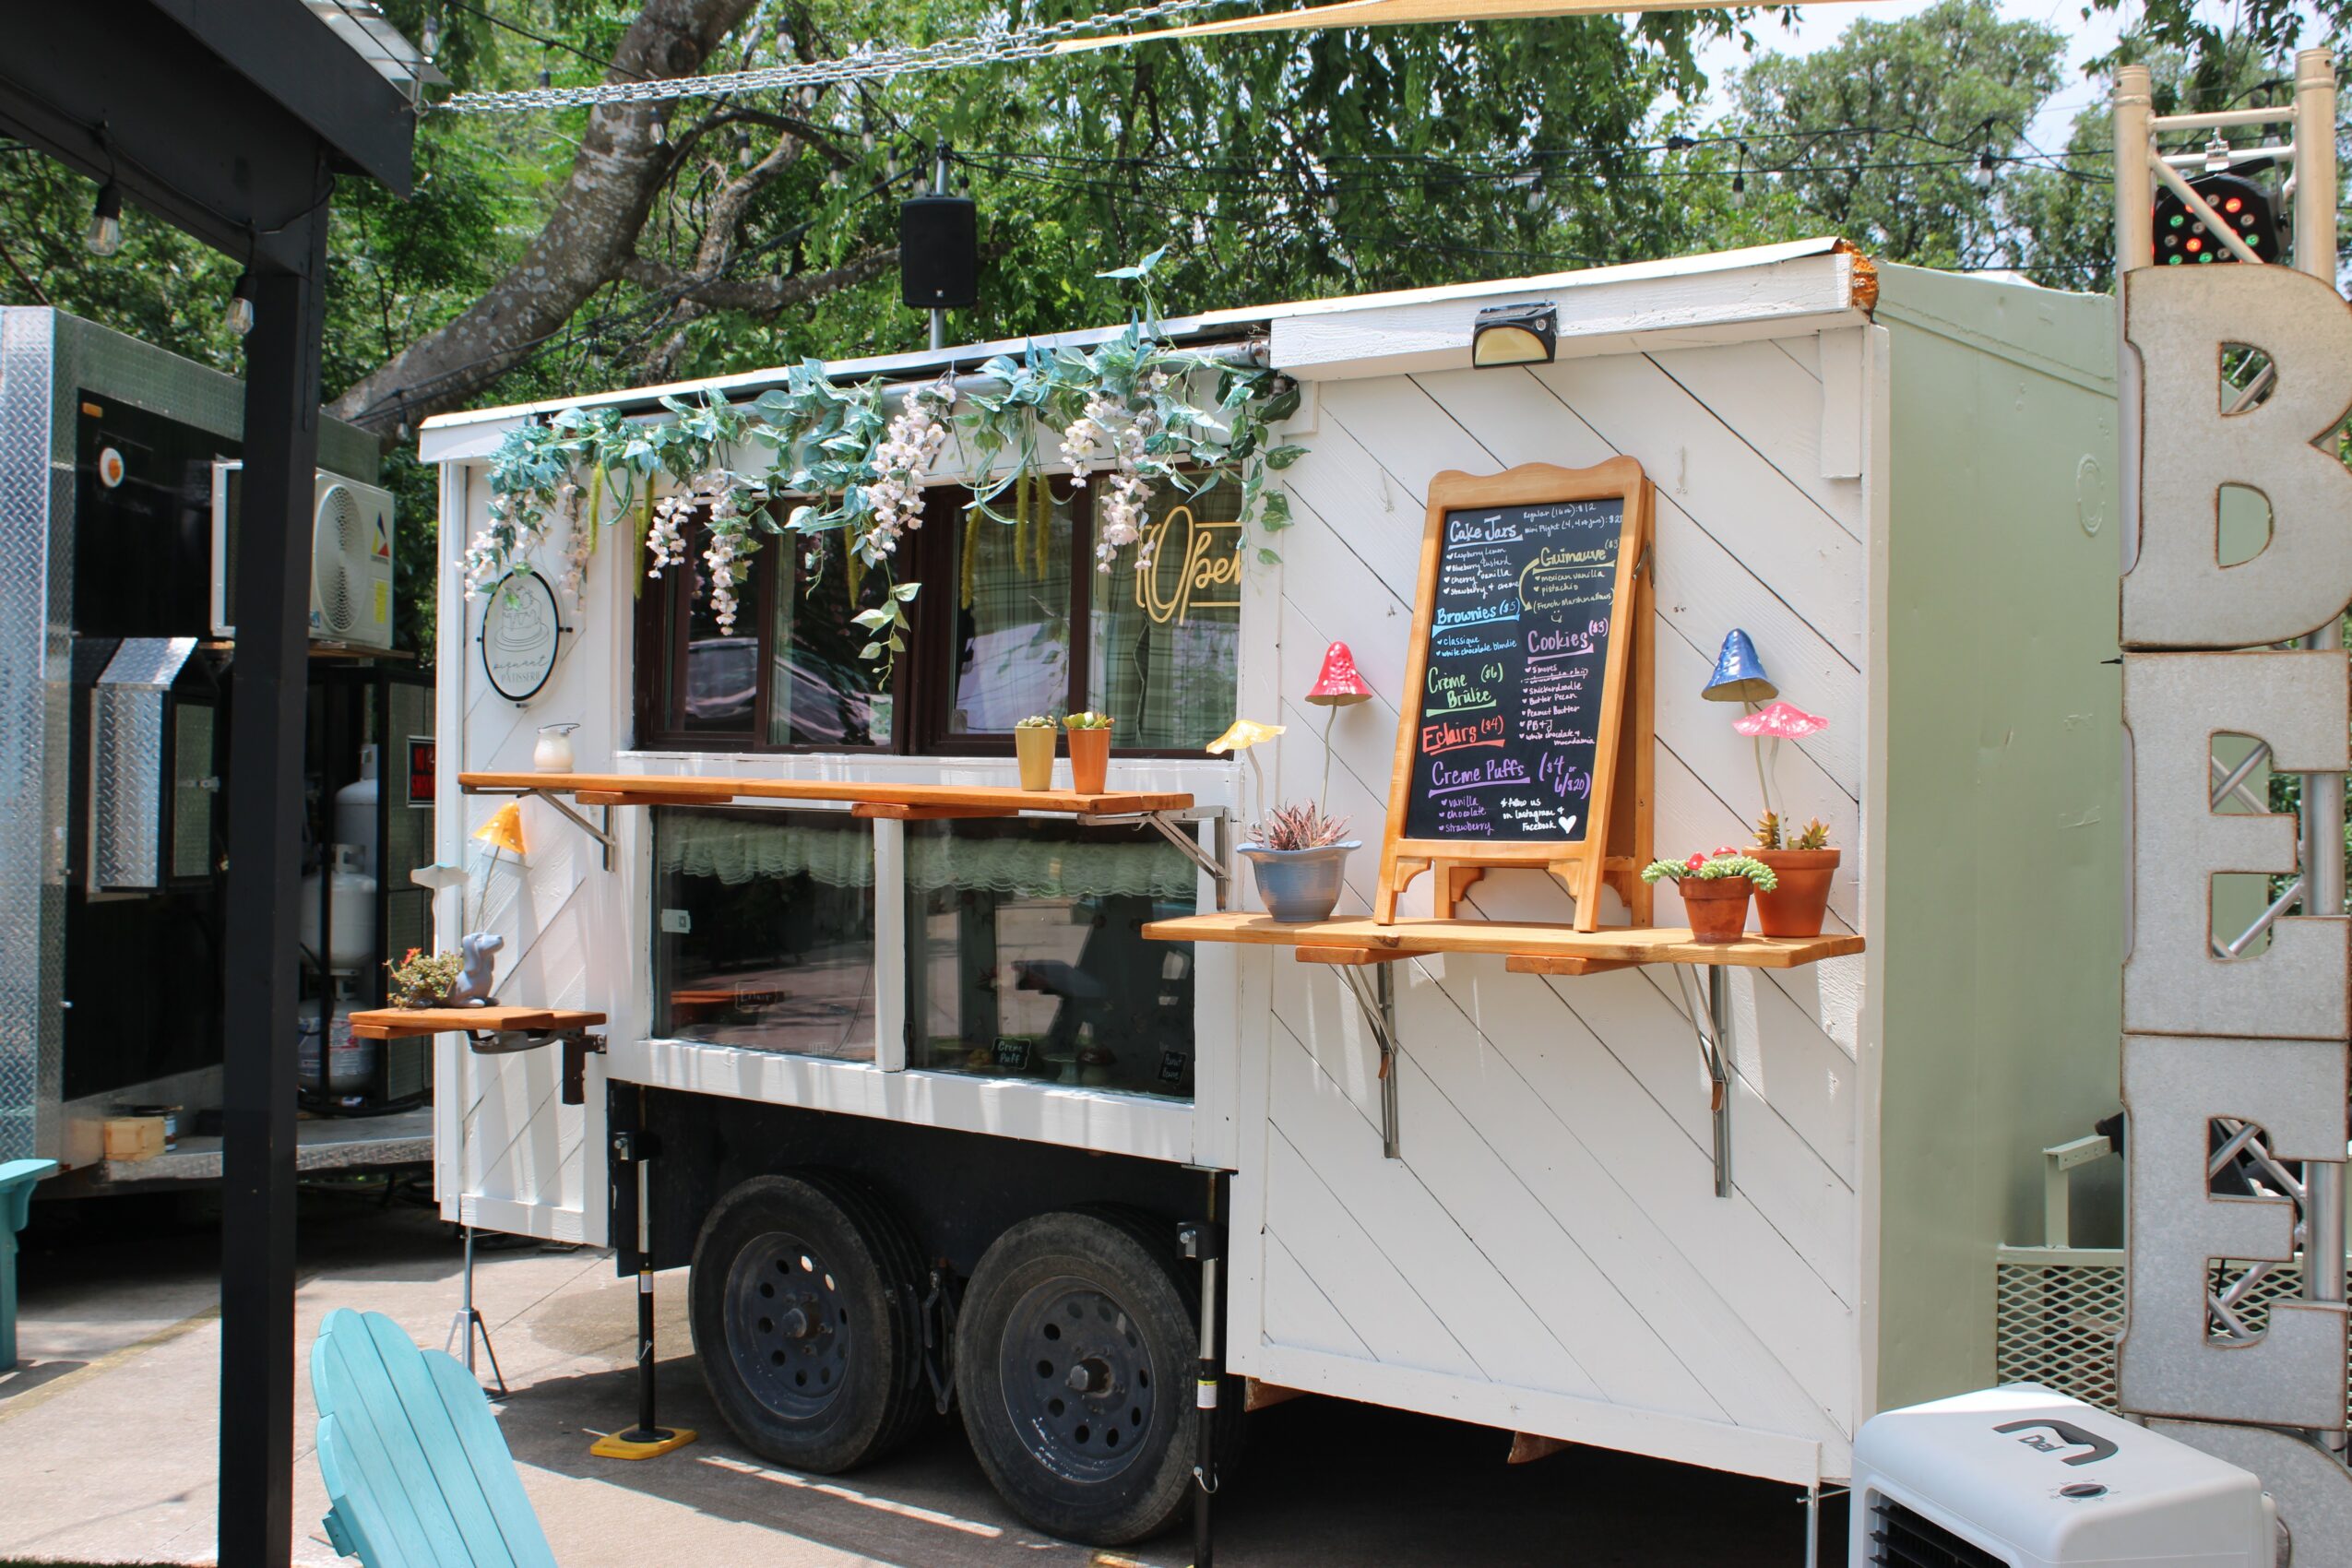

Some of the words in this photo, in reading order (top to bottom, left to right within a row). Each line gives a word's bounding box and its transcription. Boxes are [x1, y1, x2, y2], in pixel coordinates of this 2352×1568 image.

[1524, 510, 1550, 522] Regular
[1450, 520, 1482, 542] Cake
[1484, 515, 1516, 540] Jars
[1541, 547, 1606, 566] Guimauve
[1480, 568, 1513, 579] vanilla
[1573, 569, 1605, 578] vanilla
[1541, 583, 1579, 596] pistachio
[1437, 606, 1497, 624] Brownies
[1499, 598, 1520, 615] ($5)
[1443, 636, 1480, 647] classique
[1527, 630, 1588, 653] Cookies
[1588, 617, 1609, 637] ($3)
[1481, 662, 1503, 683] ($6)
[1554, 693, 1577, 701] Pecan
[1422, 722, 1477, 753] Eclairs
[1481, 716, 1503, 734] ($4)
[1432, 761, 1481, 785] Creme
[1487, 758, 1525, 780] Puffs
[1449, 795, 1479, 808] vanilla
[1530, 798, 1541, 806] us
[1447, 806, 1486, 819] chocolate
[1445, 822, 1494, 836] strawberry
[1522, 820, 1556, 831] Facebook
[2119, 265, 2352, 1568] BEE
